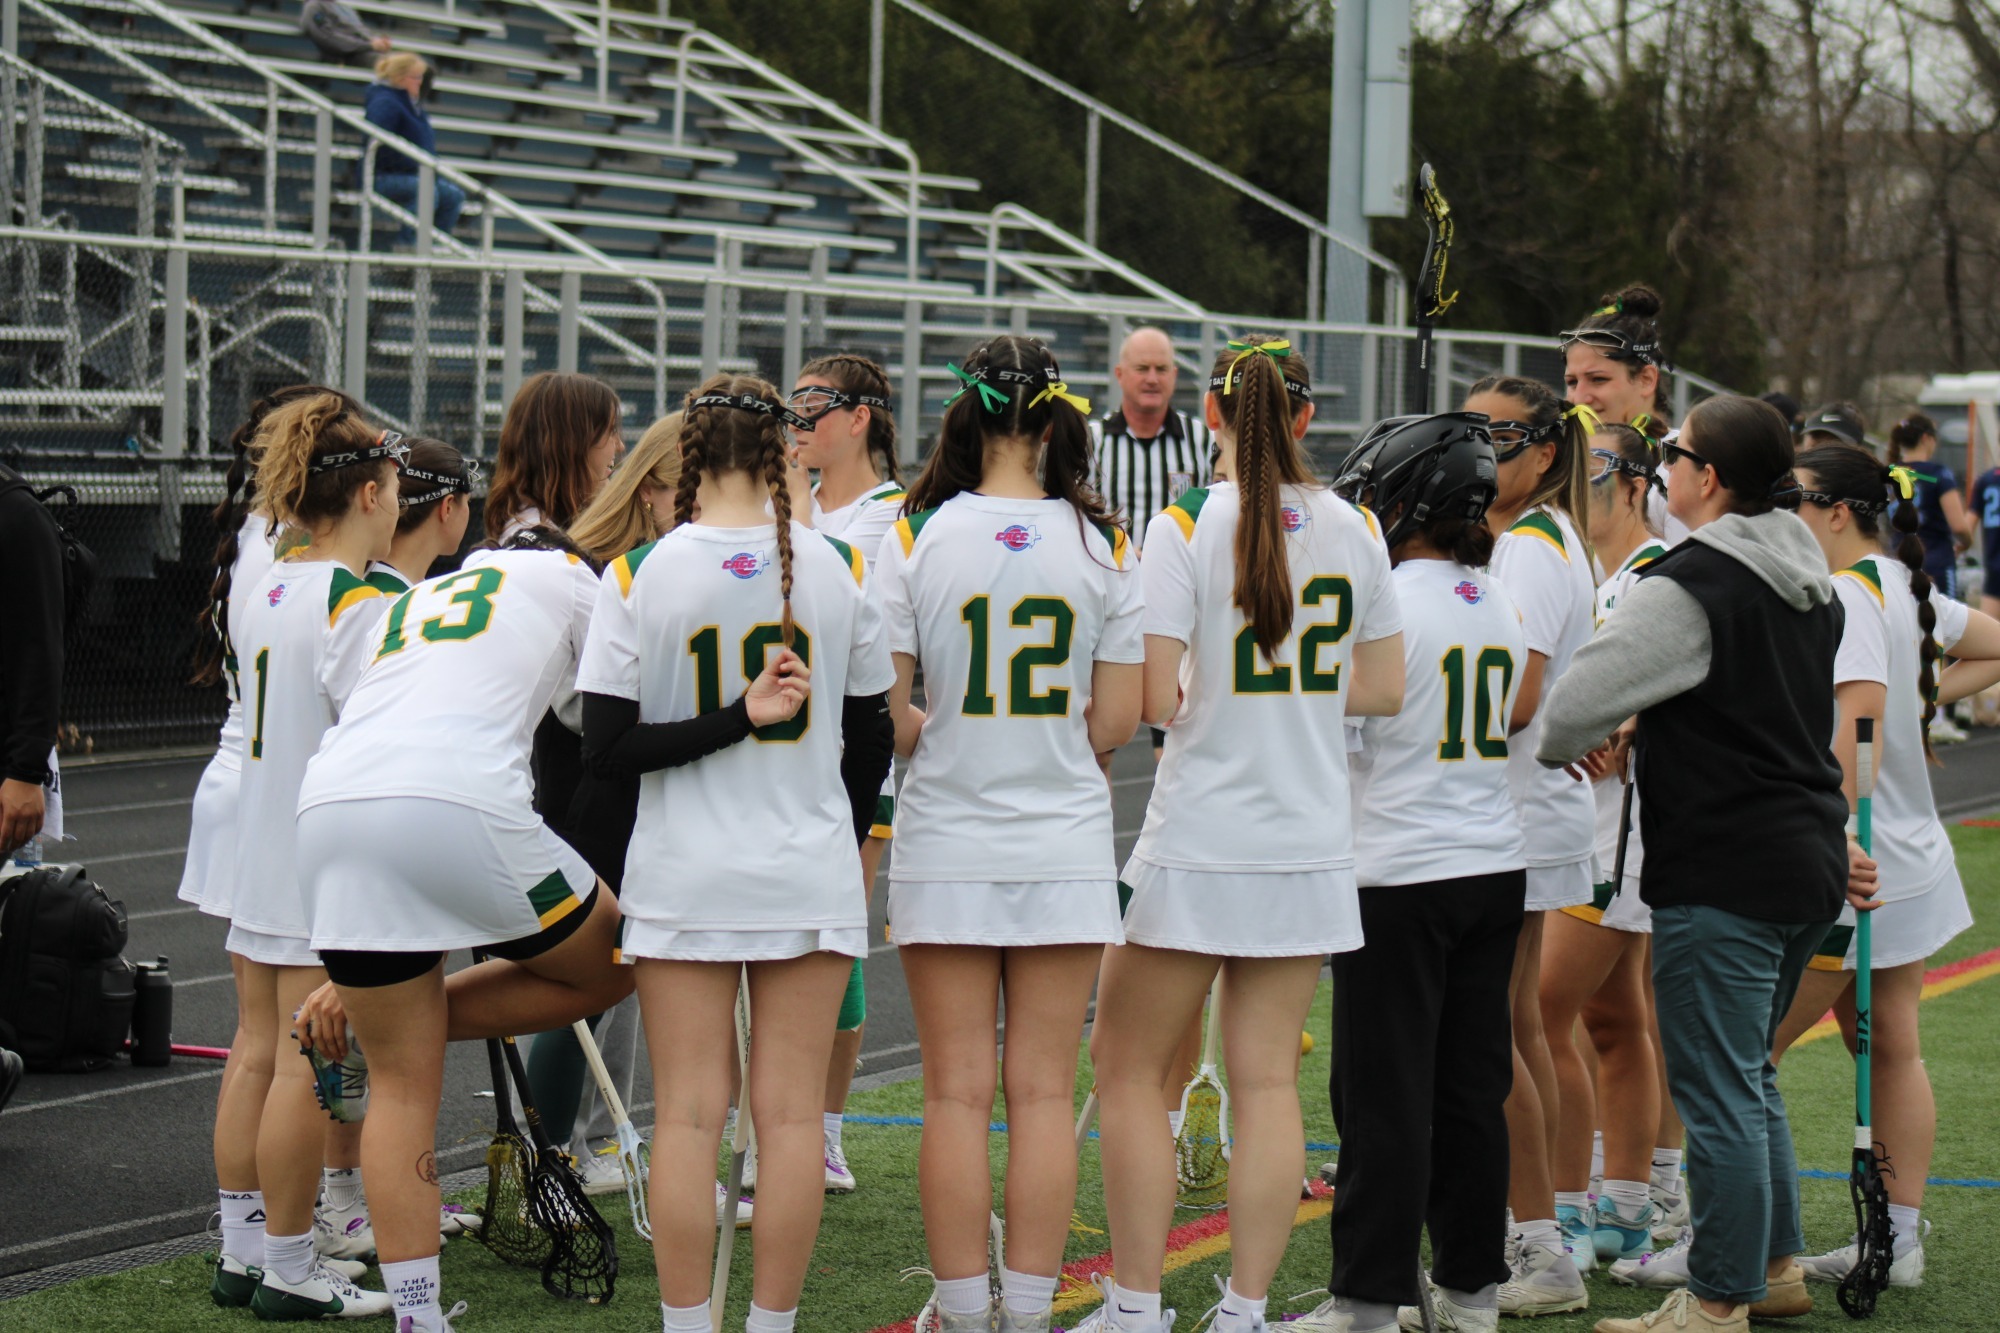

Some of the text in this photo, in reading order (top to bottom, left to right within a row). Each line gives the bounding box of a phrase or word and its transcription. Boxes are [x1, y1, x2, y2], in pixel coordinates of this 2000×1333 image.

[999, 370, 1034, 384] STX
[859, 395, 885, 407] STX
[694, 396, 732, 405] STX
[782, 411, 815, 431] STX
[322, 446, 389, 465] STX ST
[406, 468, 460, 485] GAIT GAIT
[1802, 491, 1832, 503] STX
[371, 565, 507, 665] 13
[1232, 574, 1353, 695] 22
[960, 593, 1076, 718] 12
[251, 646, 270, 761] 1
[1437, 645, 1515, 762] 10
[1856, 1008, 1869, 1056] STX
[393, 1282, 435, 1294] HARDER
[402, 1277, 427, 1286] THE
[397, 1297, 431, 1307] WORK
[402, 1291, 427, 1300] YOU
